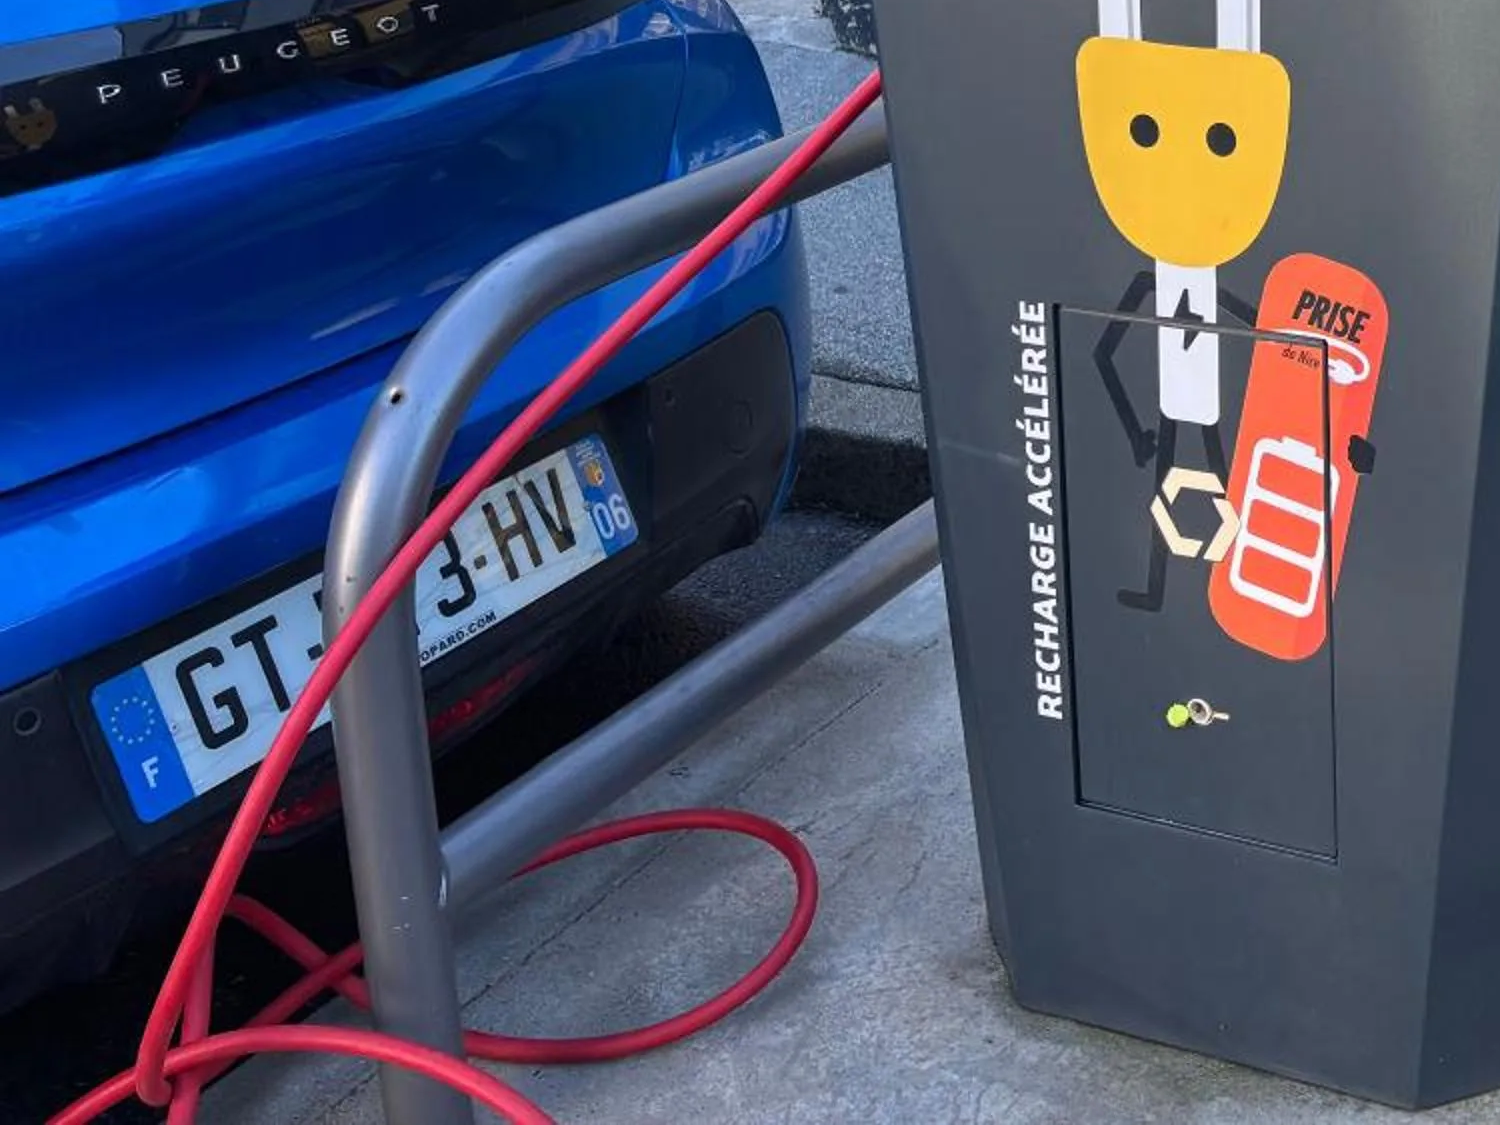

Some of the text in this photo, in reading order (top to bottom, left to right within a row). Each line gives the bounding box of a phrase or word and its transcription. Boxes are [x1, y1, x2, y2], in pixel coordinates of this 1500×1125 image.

[96, 3, 440, 105] PEUGEOT
[1291, 288, 1371, 344] PRISE
[593, 493, 631, 540] 06
[1011, 300, 1063, 720] RECHARGE ACCÉLÉRÉE
[175, 468, 577, 750] GT-3-HV
[420, 610, 498, 662] OPARD.COM
[140, 755, 160, 788] F
